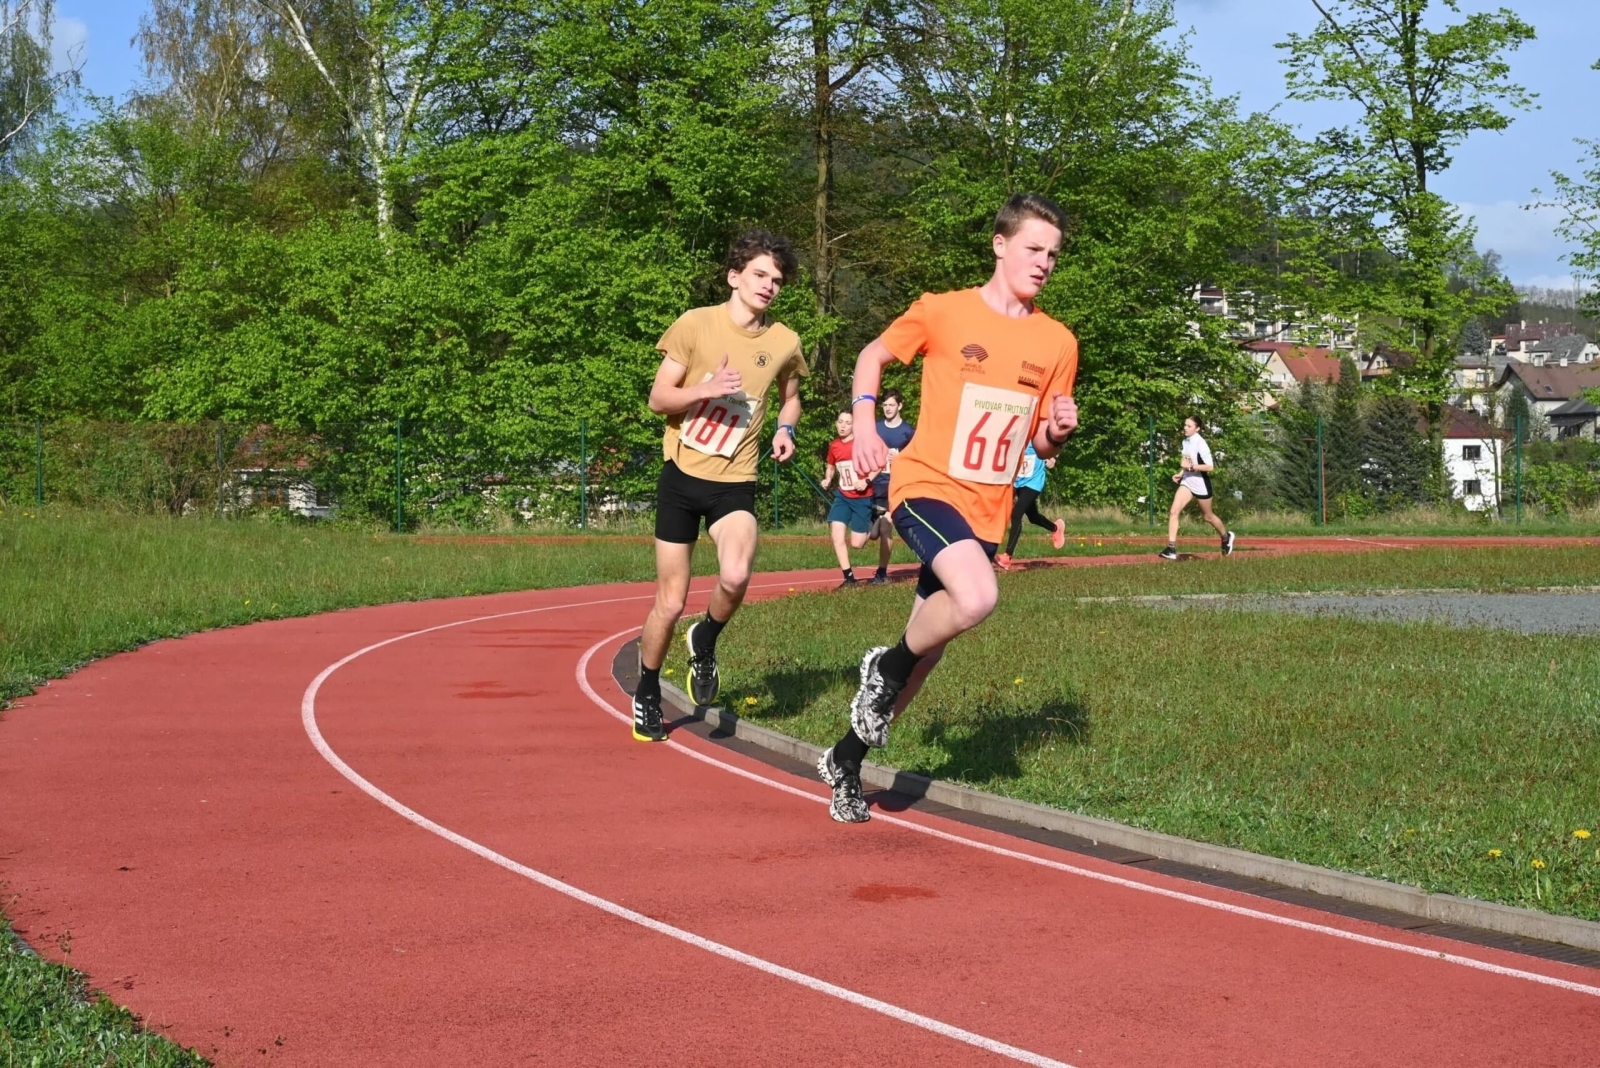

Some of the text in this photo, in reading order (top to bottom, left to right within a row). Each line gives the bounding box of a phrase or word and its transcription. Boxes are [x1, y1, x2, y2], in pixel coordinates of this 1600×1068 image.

[685, 398, 740, 453] 181
[974, 399, 1002, 411] PIVOVAR
[963, 411, 1020, 473] 66
